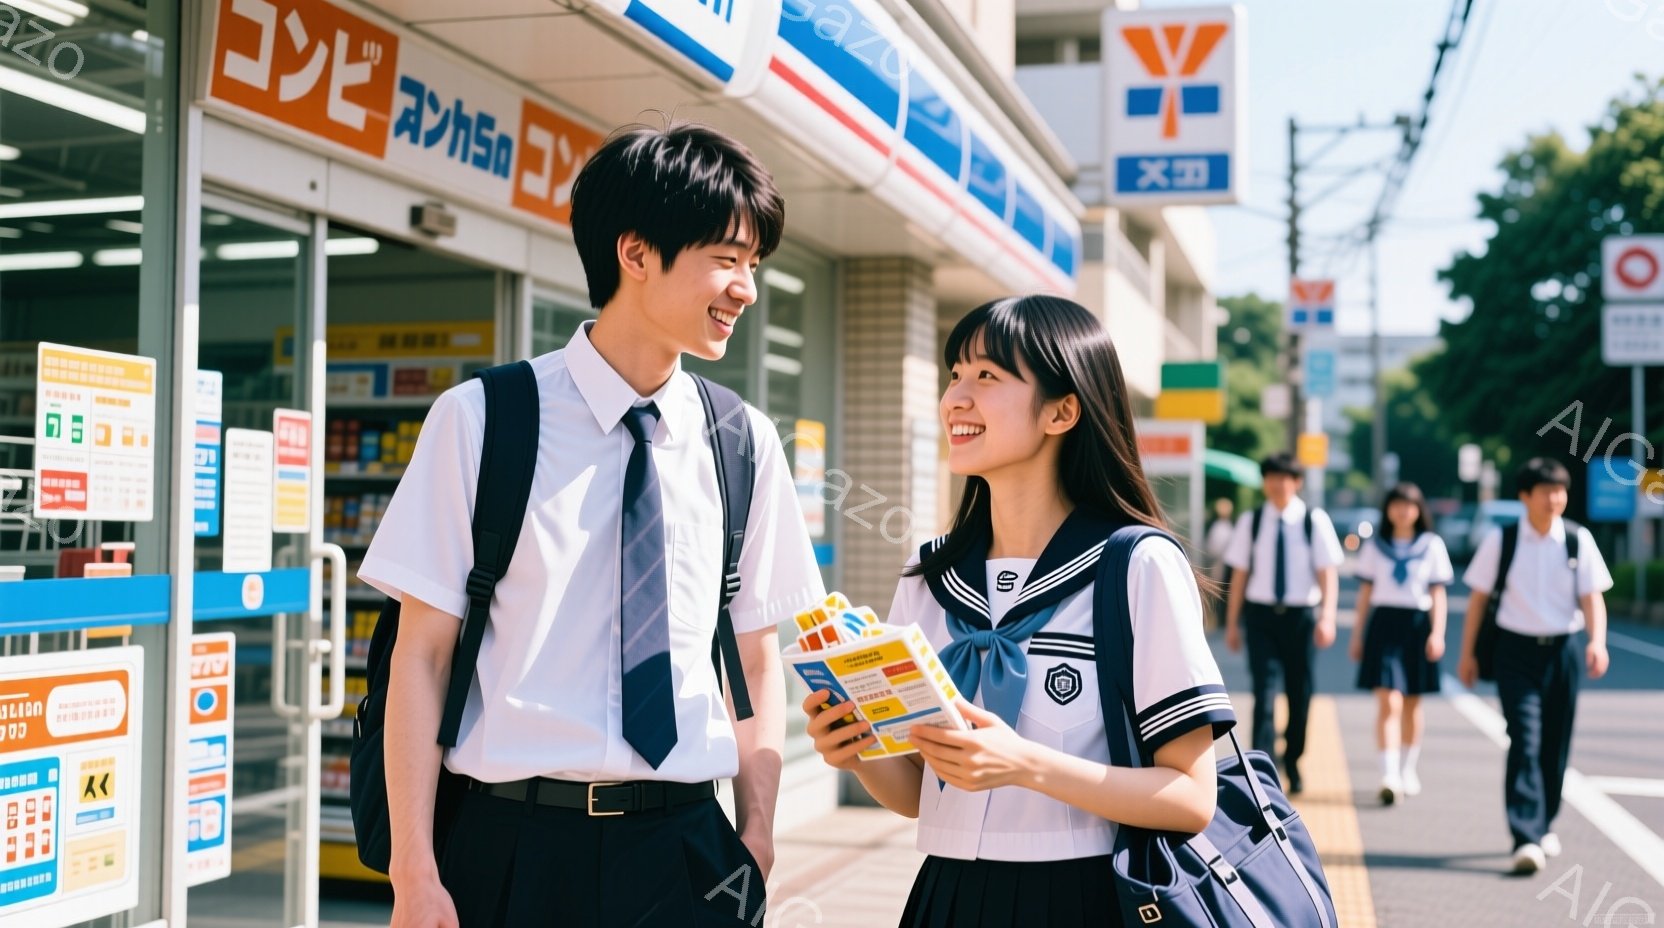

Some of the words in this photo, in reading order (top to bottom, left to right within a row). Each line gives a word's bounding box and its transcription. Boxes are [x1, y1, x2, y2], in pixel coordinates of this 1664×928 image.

[223, 0, 383, 133] コンビ
[520, 122, 597, 209] コン
